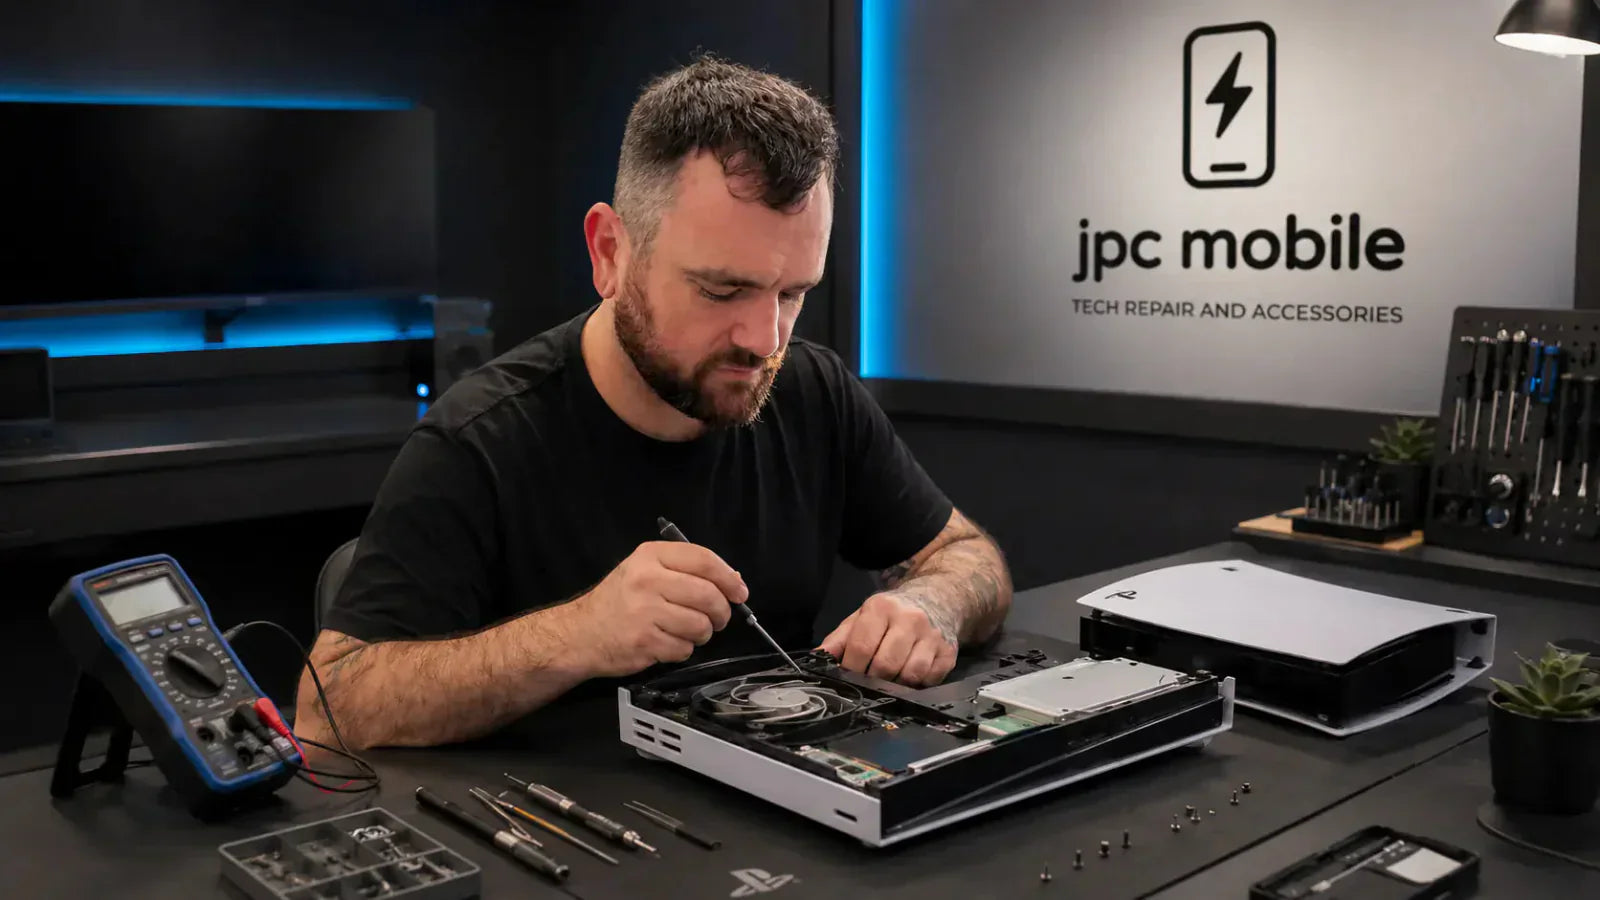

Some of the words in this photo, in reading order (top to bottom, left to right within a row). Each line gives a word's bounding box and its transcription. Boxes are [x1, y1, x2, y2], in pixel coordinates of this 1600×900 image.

[1071, 218, 1162, 283] jpc
[1182, 212, 1406, 272] mobile
[1071, 298, 1119, 315] TECH
[1125, 300, 1194, 317] REPAIR
[1200, 302, 1246, 319] AND
[1252, 303, 1404, 324] ACCESSORIES
